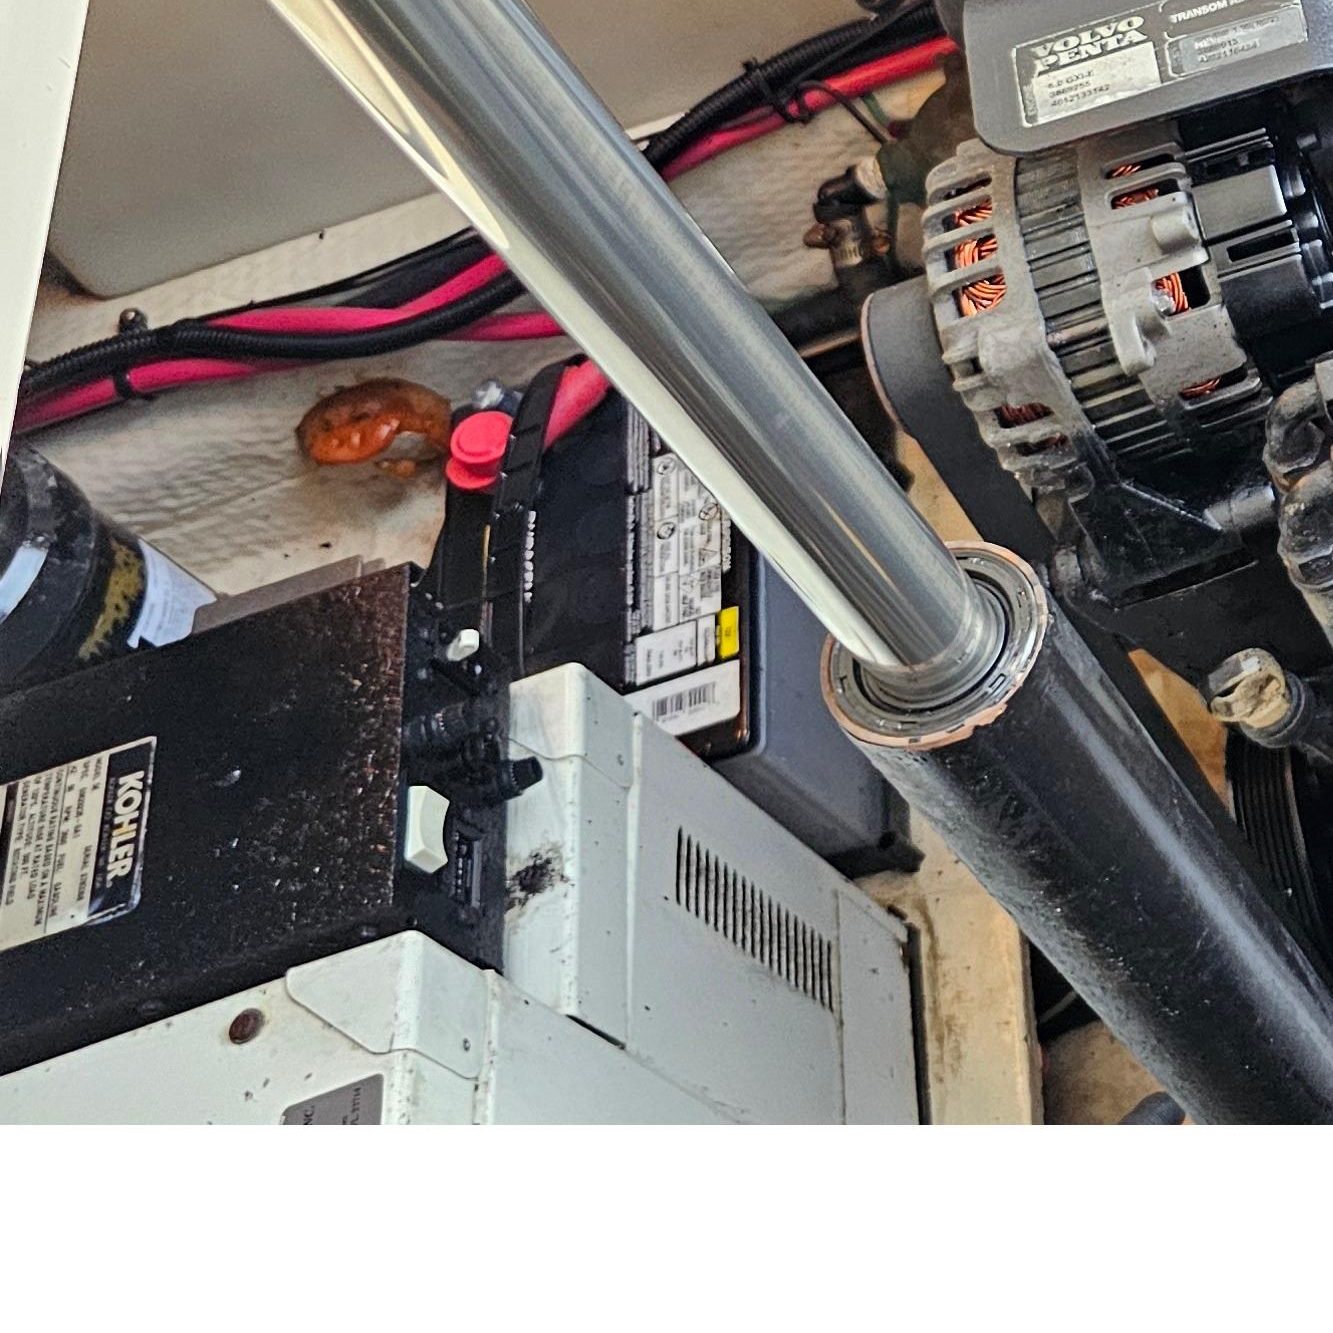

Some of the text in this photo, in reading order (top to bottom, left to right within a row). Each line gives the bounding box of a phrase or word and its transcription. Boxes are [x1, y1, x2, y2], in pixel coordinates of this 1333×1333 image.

[1030, 16, 1145, 58] VOLVO
[1034, 29, 1148, 72] PENTA
[107, 769, 145, 883] KOHLER
